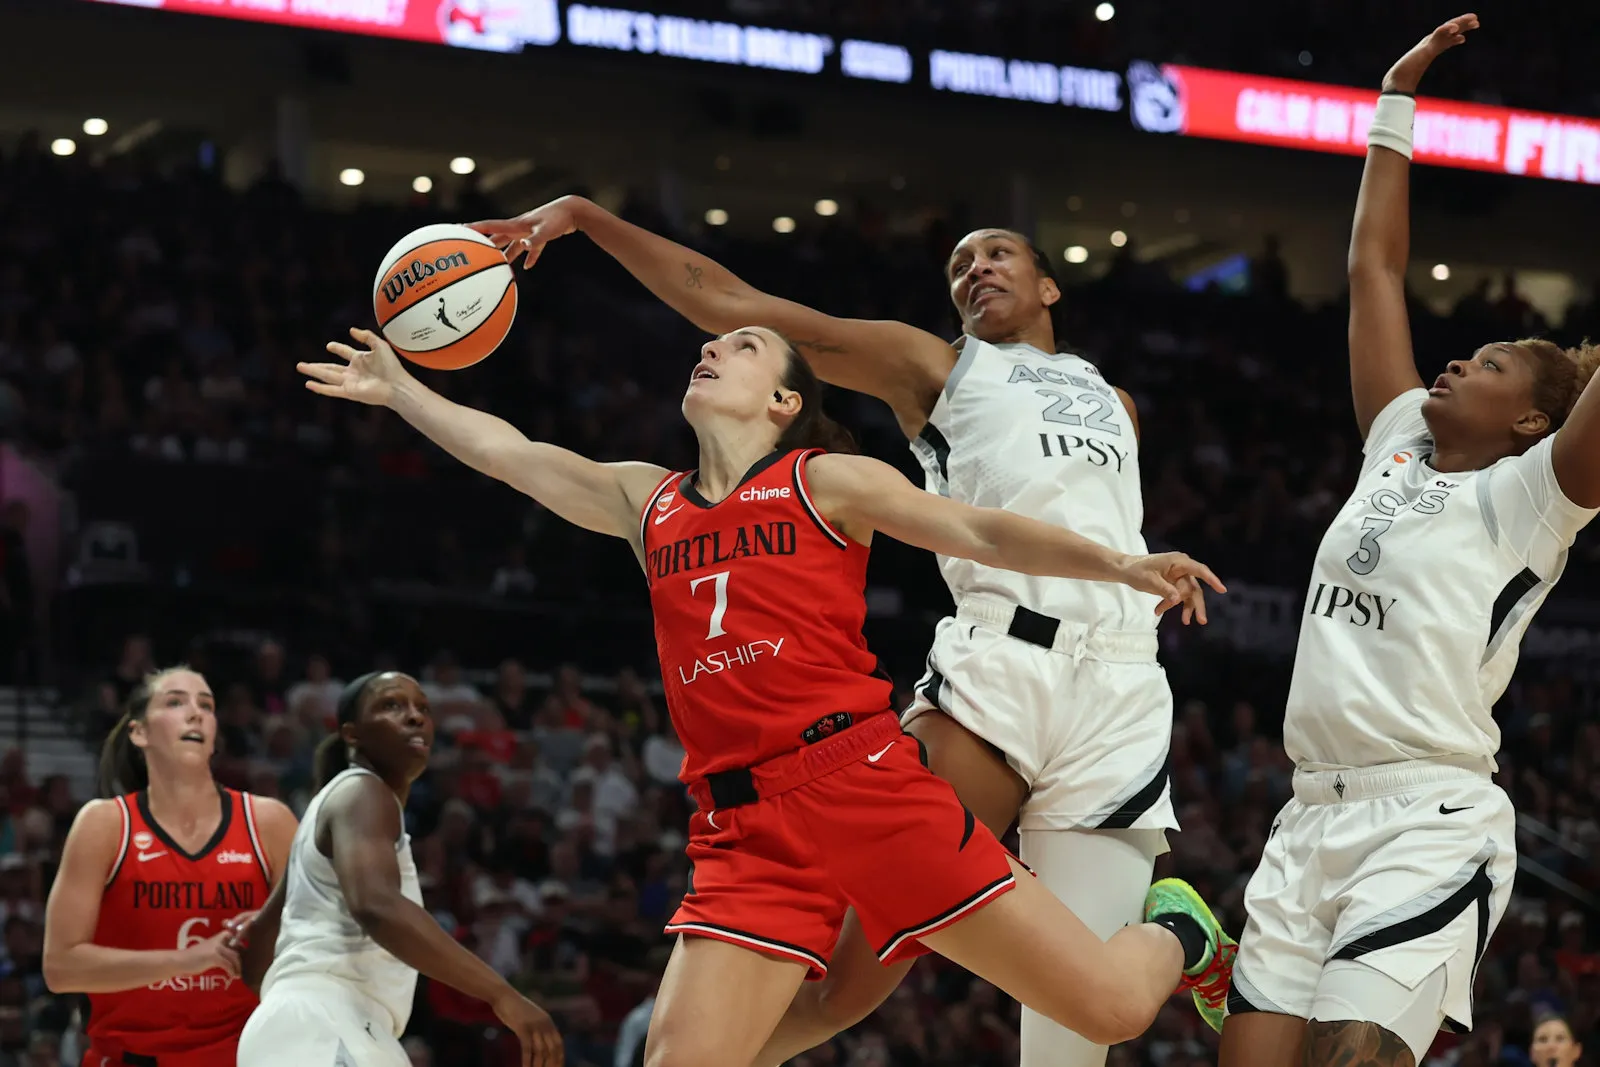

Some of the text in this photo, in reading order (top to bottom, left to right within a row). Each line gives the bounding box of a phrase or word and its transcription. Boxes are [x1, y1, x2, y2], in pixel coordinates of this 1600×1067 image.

[929, 50, 1059, 104] PORTLAND
[381, 251, 470, 304] Wilson
[1035, 388, 1121, 436] 22
[1038, 433, 1128, 474] IPSY
[739, 486, 791, 502] chime
[649, 521, 797, 587] PORTLAND
[1346, 516, 1393, 575] 3
[690, 571, 730, 641] 7
[1310, 583, 1397, 630] IPSY
[679, 637, 784, 685] LASHIFY
[134, 880, 254, 910] PORTLAND
